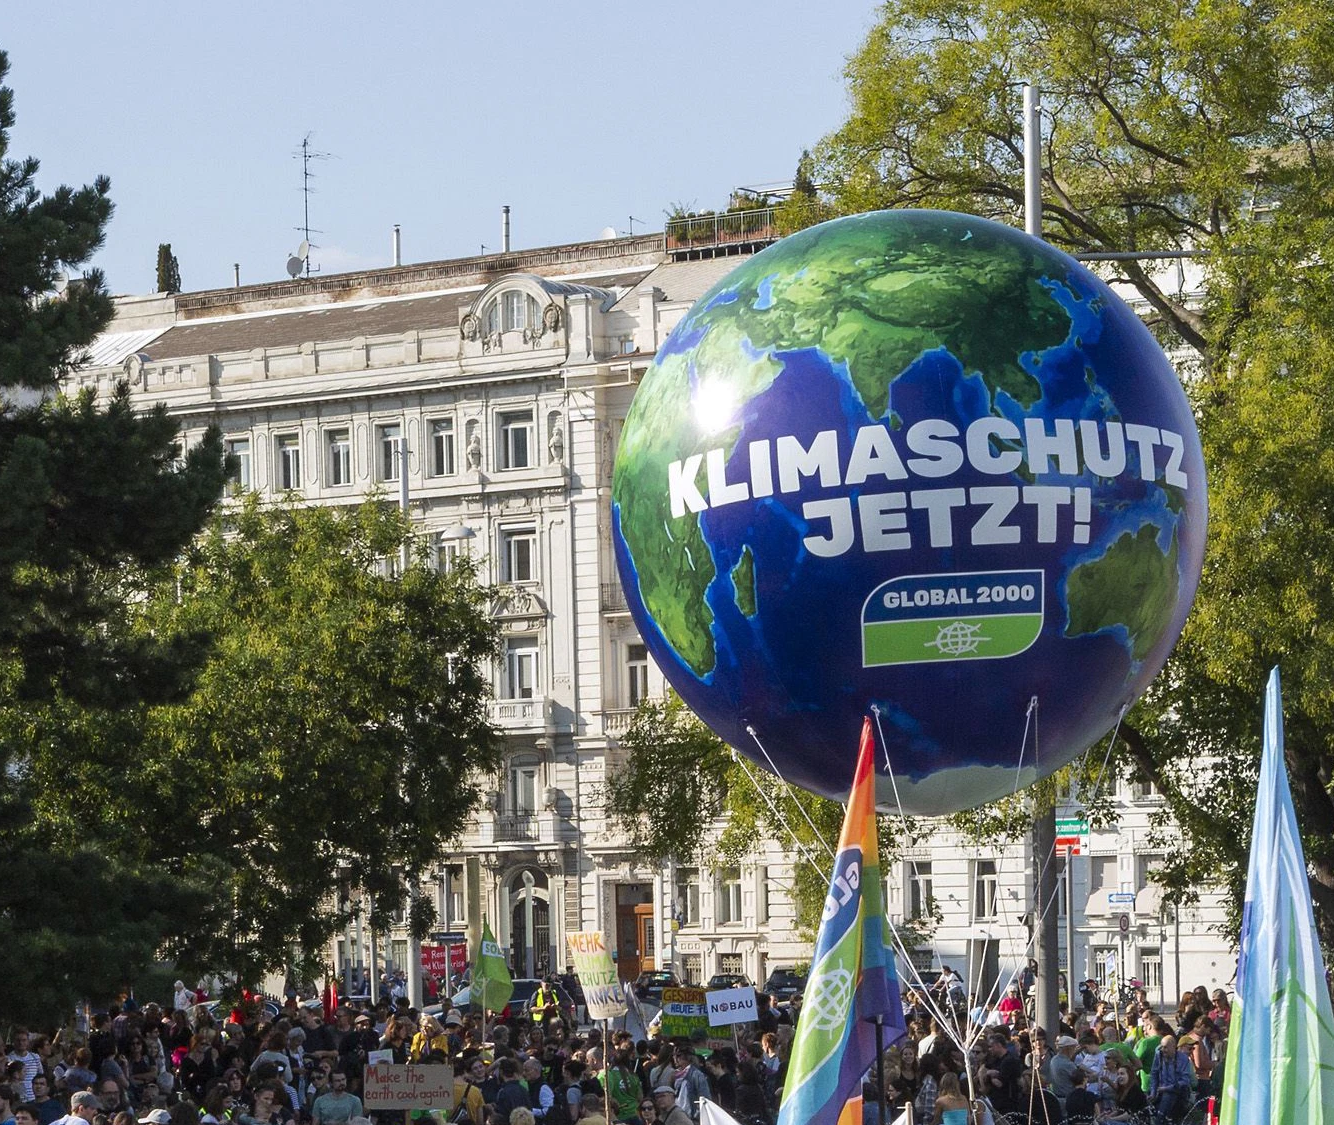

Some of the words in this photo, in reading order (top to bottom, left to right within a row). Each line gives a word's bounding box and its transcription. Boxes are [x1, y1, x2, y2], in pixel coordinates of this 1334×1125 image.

[668, 418, 1188, 518] KLIMASCHUTZ
[803, 487, 1090, 557] JETZT!
[883, 589, 973, 608] GLOBAL
[977, 585, 1035, 602] 2000
[366, 1066, 401, 1084] Make
[365, 1084, 393, 1100] earth
[397, 1084, 418, 1100] cool
[419, 1085, 450, 1106] again
